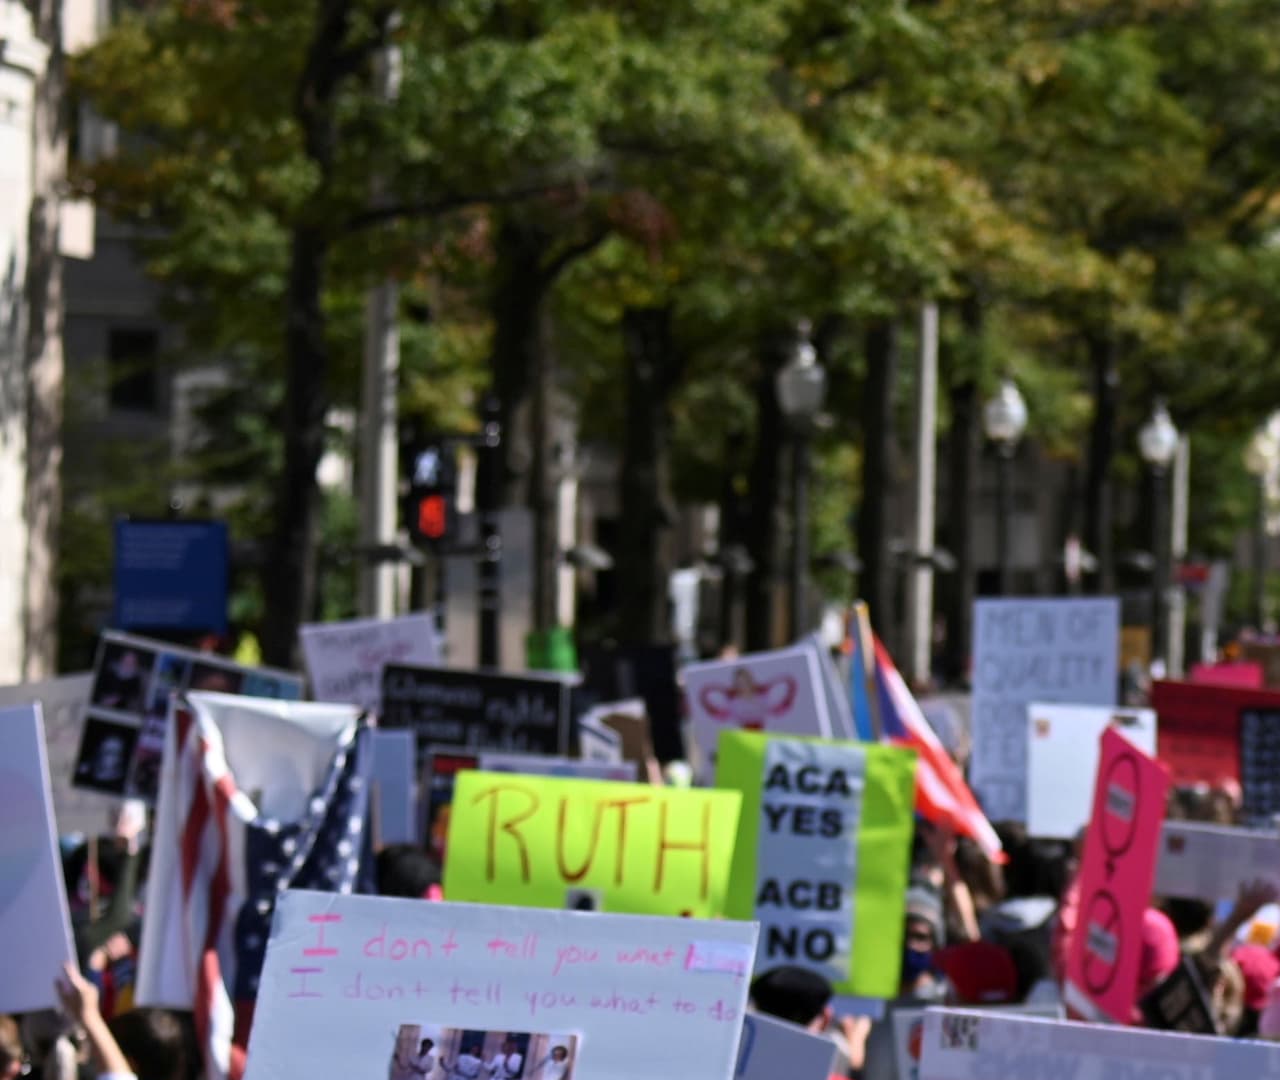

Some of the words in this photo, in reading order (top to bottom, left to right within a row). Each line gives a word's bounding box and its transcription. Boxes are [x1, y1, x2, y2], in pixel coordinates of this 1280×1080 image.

[982, 607, 1054, 647] MEN
[979, 654, 1108, 695] QUALITY
[765, 761, 855, 799] ACA
[473, 782, 712, 899] RUTH
[763, 804, 846, 839] YES
[755, 876, 844, 912] ACB
[303, 912, 344, 957] I
[486, 929, 538, 960] tell
[552, 945, 600, 977] you
[616, 943, 677, 967] what
[765, 926, 836, 962] NO
[288, 966, 325, 999] I
[448, 976, 502, 1006] tell
[525, 990, 577, 1017] you
[589, 986, 660, 1015] what
[671, 993, 697, 1015] to
[707, 998, 739, 1022] do
